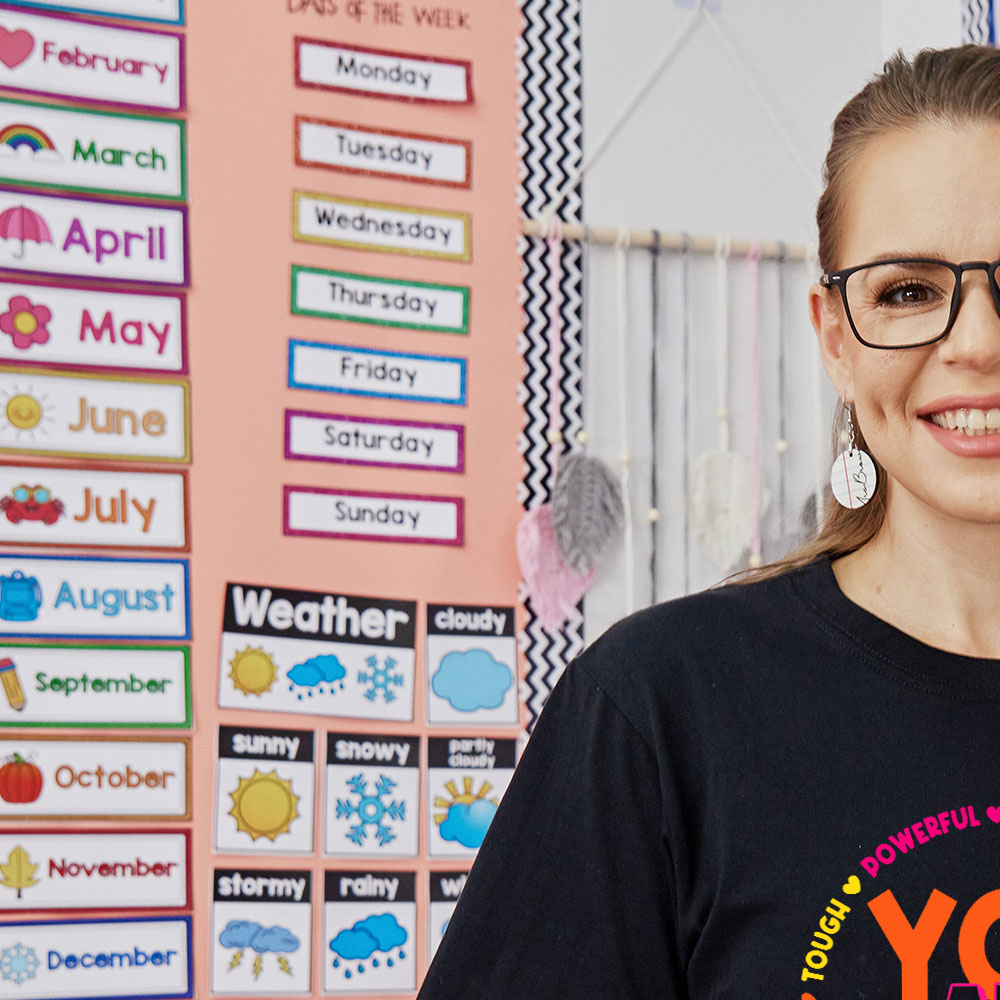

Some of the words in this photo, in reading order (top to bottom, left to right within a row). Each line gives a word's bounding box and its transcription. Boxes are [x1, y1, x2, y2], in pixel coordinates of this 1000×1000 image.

[346, 0, 365, 23] OF
[374, 2, 402, 25] THE
[412, 5, 471, 29] WEEK
[43, 41, 168, 83] February
[337, 56, 431, 90] Monday
[73, 139, 165, 170] March
[337, 135, 433, 170] Tuesday
[62, 218, 165, 263] April
[315, 208, 452, 245] Wednesday
[328, 282, 437, 316] Thursday
[79, 309, 170, 355] May
[340, 357, 416, 387] Friday
[69, 397, 166, 437] June
[325, 426, 434, 456] Saturday
[74, 488, 156, 533] July
[335, 502, 419, 529] Sunday
[54, 581, 174, 616] August
[233, 587, 409, 639] Weather
[435, 610, 505, 634] cloudy
[36, 672, 172, 697] September
[232, 733, 299, 760] sunny
[335, 740, 410, 766] snowy
[449, 738, 495, 753] partly
[448, 753, 496, 769] cloudy
[55, 765, 175, 789] October
[860, 805, 980, 878] POWERFUL
[49, 858, 178, 878] November
[218, 873, 306, 902] stormy
[340, 874, 400, 900] rainy
[801, 898, 851, 982] TOUGH
[48, 947, 177, 971] December
